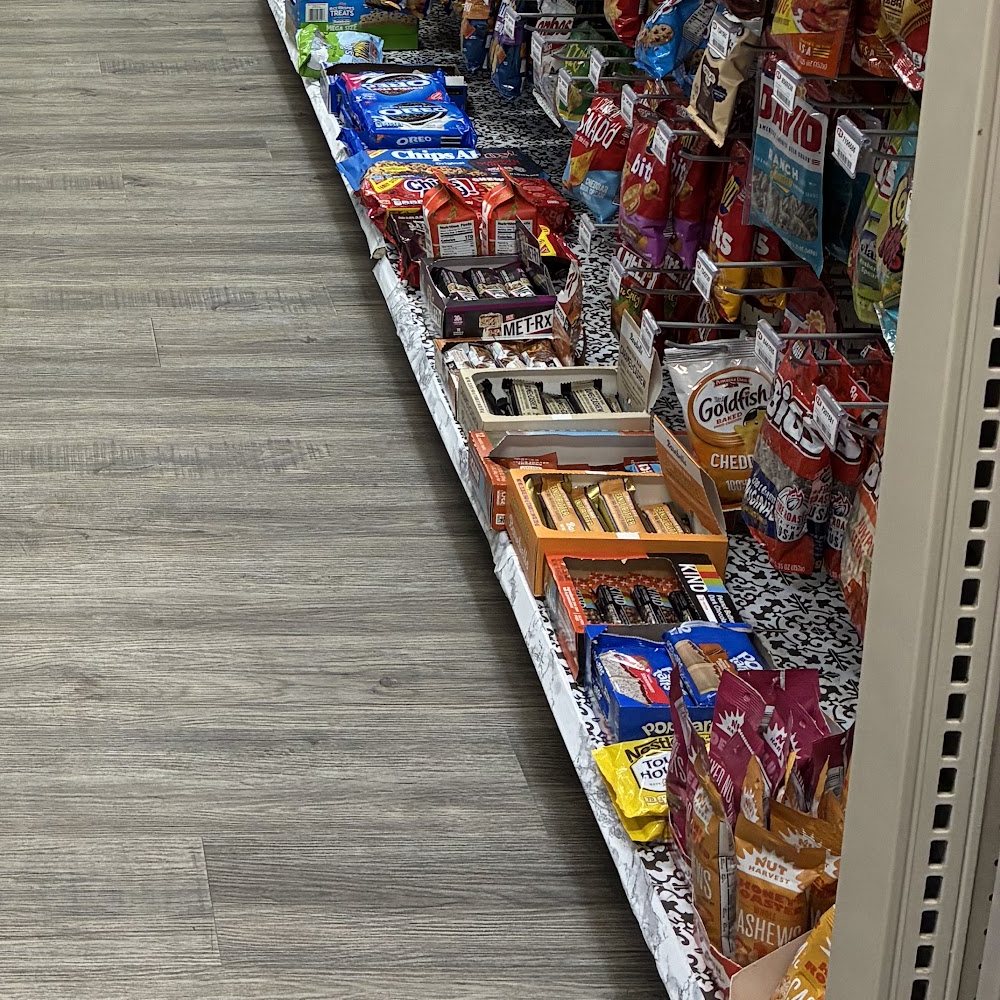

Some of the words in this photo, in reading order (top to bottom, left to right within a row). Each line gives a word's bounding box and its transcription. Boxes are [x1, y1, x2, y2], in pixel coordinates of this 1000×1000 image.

[379, 105, 448, 117] OREO
[759, 84, 824, 154] DAVID
[396, 136, 431, 145] OREO
[391, 150, 455, 161] Chips
[768, 148, 799, 181] RANCH
[585, 175, 609, 193] CHEDDAR
[712, 215, 733, 256] its
[699, 384, 768, 423] Goldfish
[716, 412, 743, 425] BAKED
[679, 564, 708, 593] KIND
[749, 865, 790, 884] HARVEST
[755, 858, 787, 875] NUT
